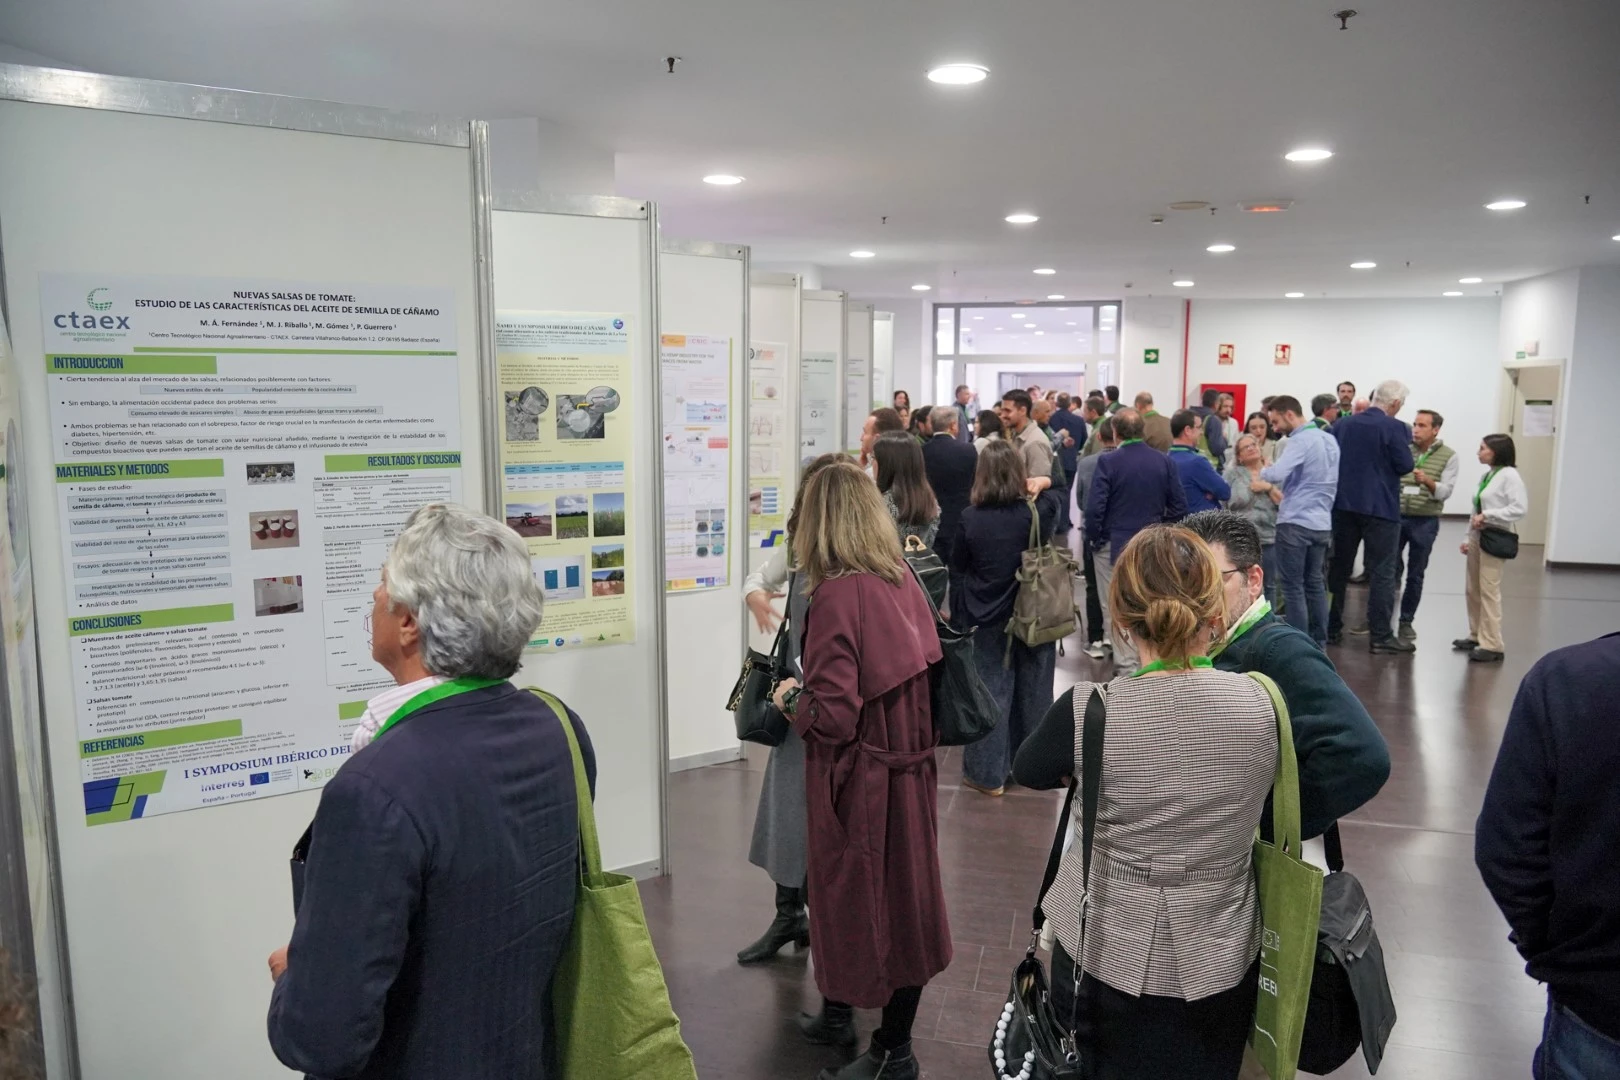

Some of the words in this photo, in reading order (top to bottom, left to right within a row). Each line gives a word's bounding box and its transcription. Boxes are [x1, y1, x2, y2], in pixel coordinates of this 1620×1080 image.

[135, 299, 176, 307] ESTUDIO
[212, 302, 291, 311] CARACTERÍSTICAS
[402, 307, 439, 315] CÁÑAMO
[53, 311, 130, 329] ctaex
[368, 455, 415, 466] RESULTADOS
[416, 455, 421, 464] Y
[422, 454, 460, 464] DISCUSION
[56, 465, 116, 477] MATERIALES
[117, 464, 123, 475] Y
[125, 463, 169, 474] METODOS
[72, 614, 141, 631] CONCLUSIONES
[83, 734, 144, 753] REFERENCIAS
[184, 769, 188, 778] I
[192, 756, 272, 777] SYMPOSIUM
[276, 748, 327, 764] IBÉRICO
[201, 781, 244, 791] interreg
